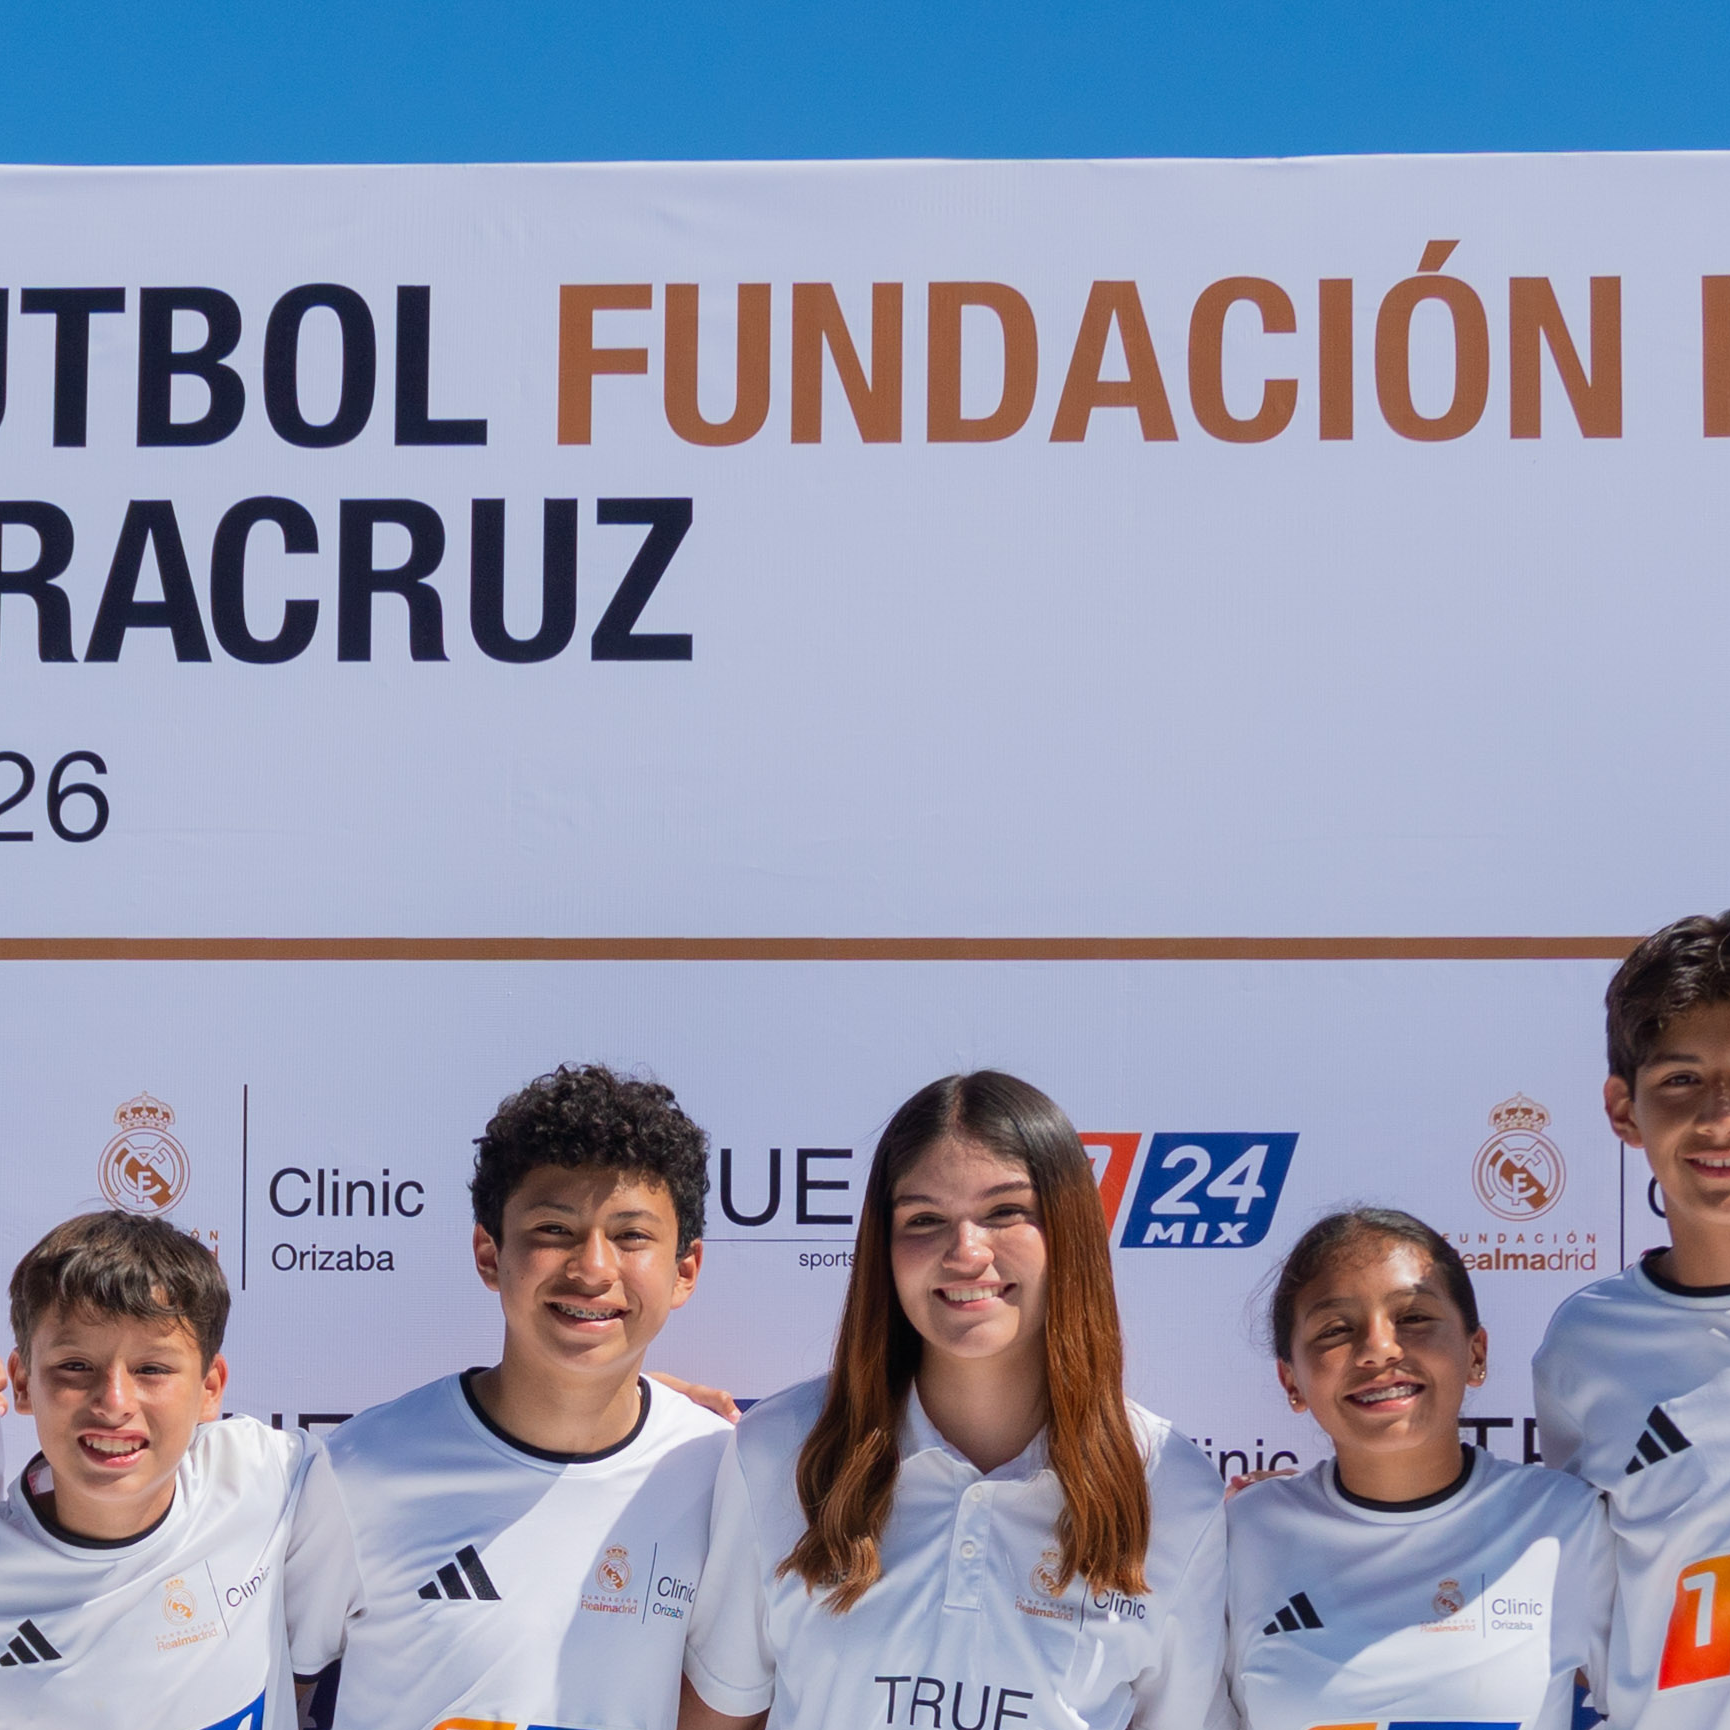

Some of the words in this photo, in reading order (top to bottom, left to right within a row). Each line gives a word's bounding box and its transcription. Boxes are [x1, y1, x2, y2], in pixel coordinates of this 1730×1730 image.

[556, 239, 1623, 447] FUNDACIÓN
[269, 1166, 425, 1219] Clinic
[720, 1148, 853, 1227] UE
[1150, 1144, 1270, 1215] 24
[1141, 1221, 1250, 1245] MIX
[271, 1242, 395, 1273] Orizaba
[1463, 1248, 1597, 1271] ealmadrid
[1491, 1598, 1543, 1616] Clinic
